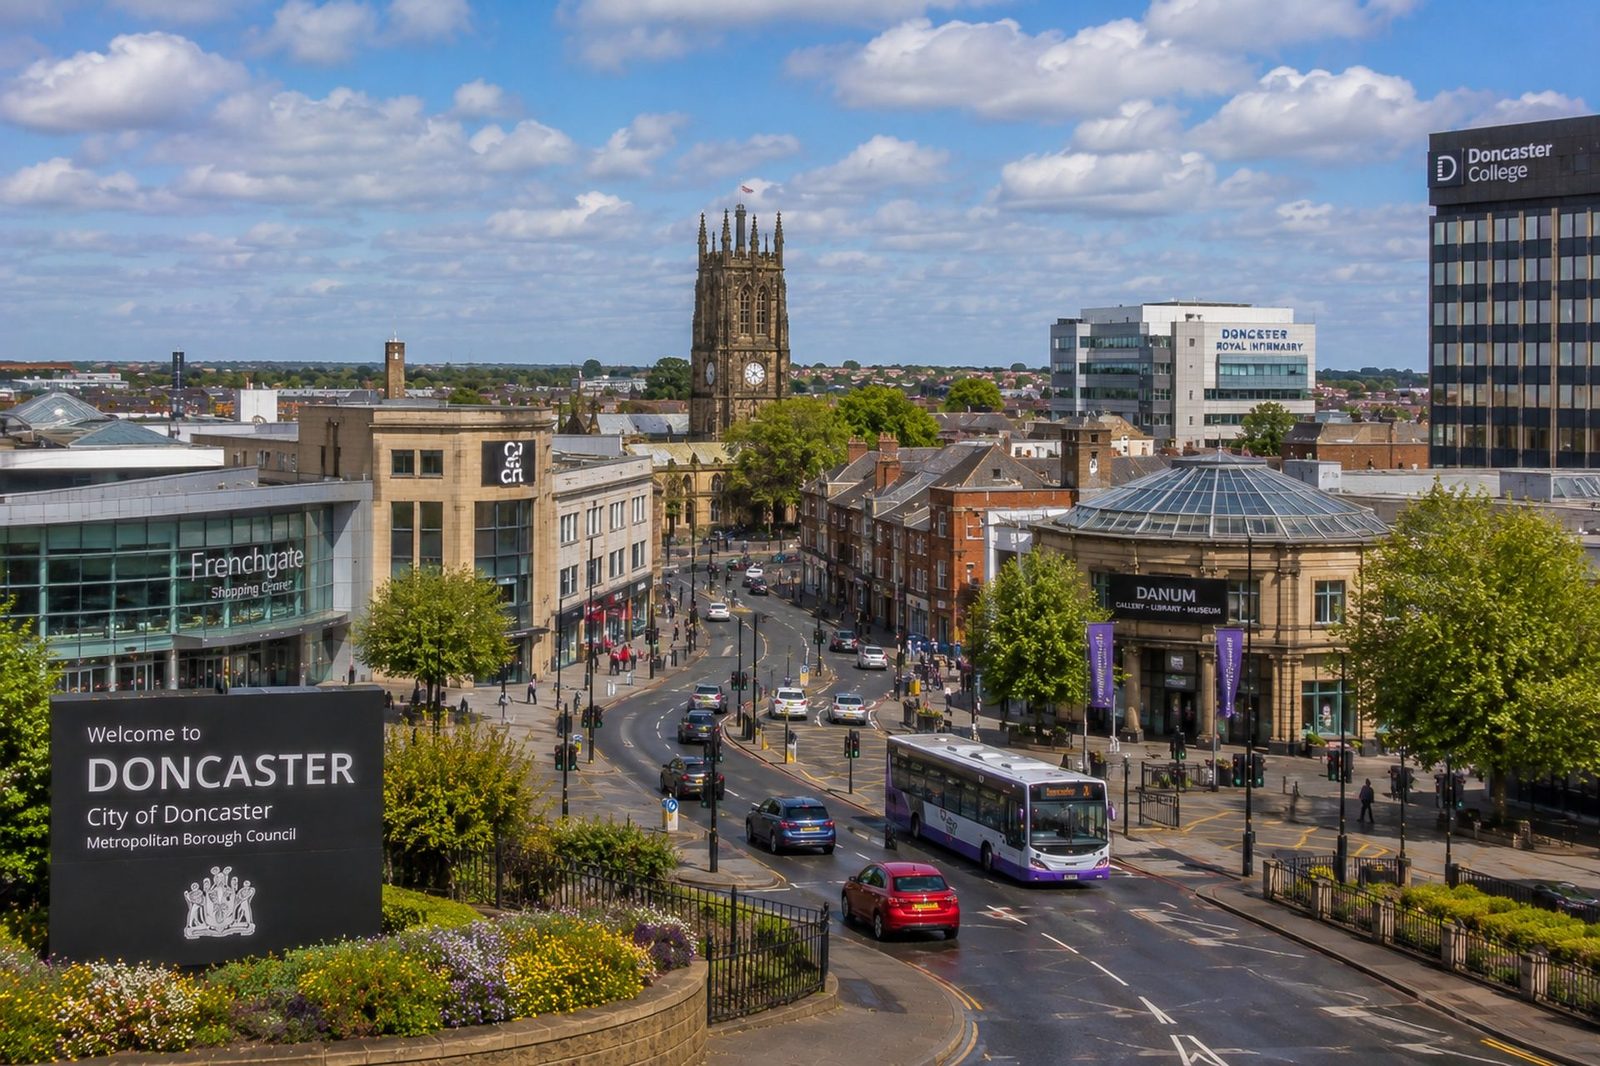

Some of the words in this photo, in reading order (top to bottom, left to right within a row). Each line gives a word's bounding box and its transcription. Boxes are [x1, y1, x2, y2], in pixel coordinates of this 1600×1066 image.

[1468, 143, 1552, 164] Doncaster
[1468, 164, 1528, 183] College
[1216, 342, 1247, 351] ROYAL
[191, 547, 304, 582] Frenchgate
[211, 583, 259, 599] Shopping
[1136, 586, 1196, 603] DANUM
[1115, 602, 1145, 610] GALLERY
[1150, 604, 1182, 613] LIBRARY
[1187, 606, 1221, 615] MUSEUM
[87, 726, 176, 744] Welcome
[182, 725, 201, 742] to
[88, 752, 355, 793] DONCASTER
[87, 806, 129, 831] City
[135, 805, 159, 825] of
[164, 803, 273, 824] Doncaster
[86, 834, 179, 850] Metropolitan
[183, 831, 242, 847] Borough
[246, 828, 296, 843] Council
